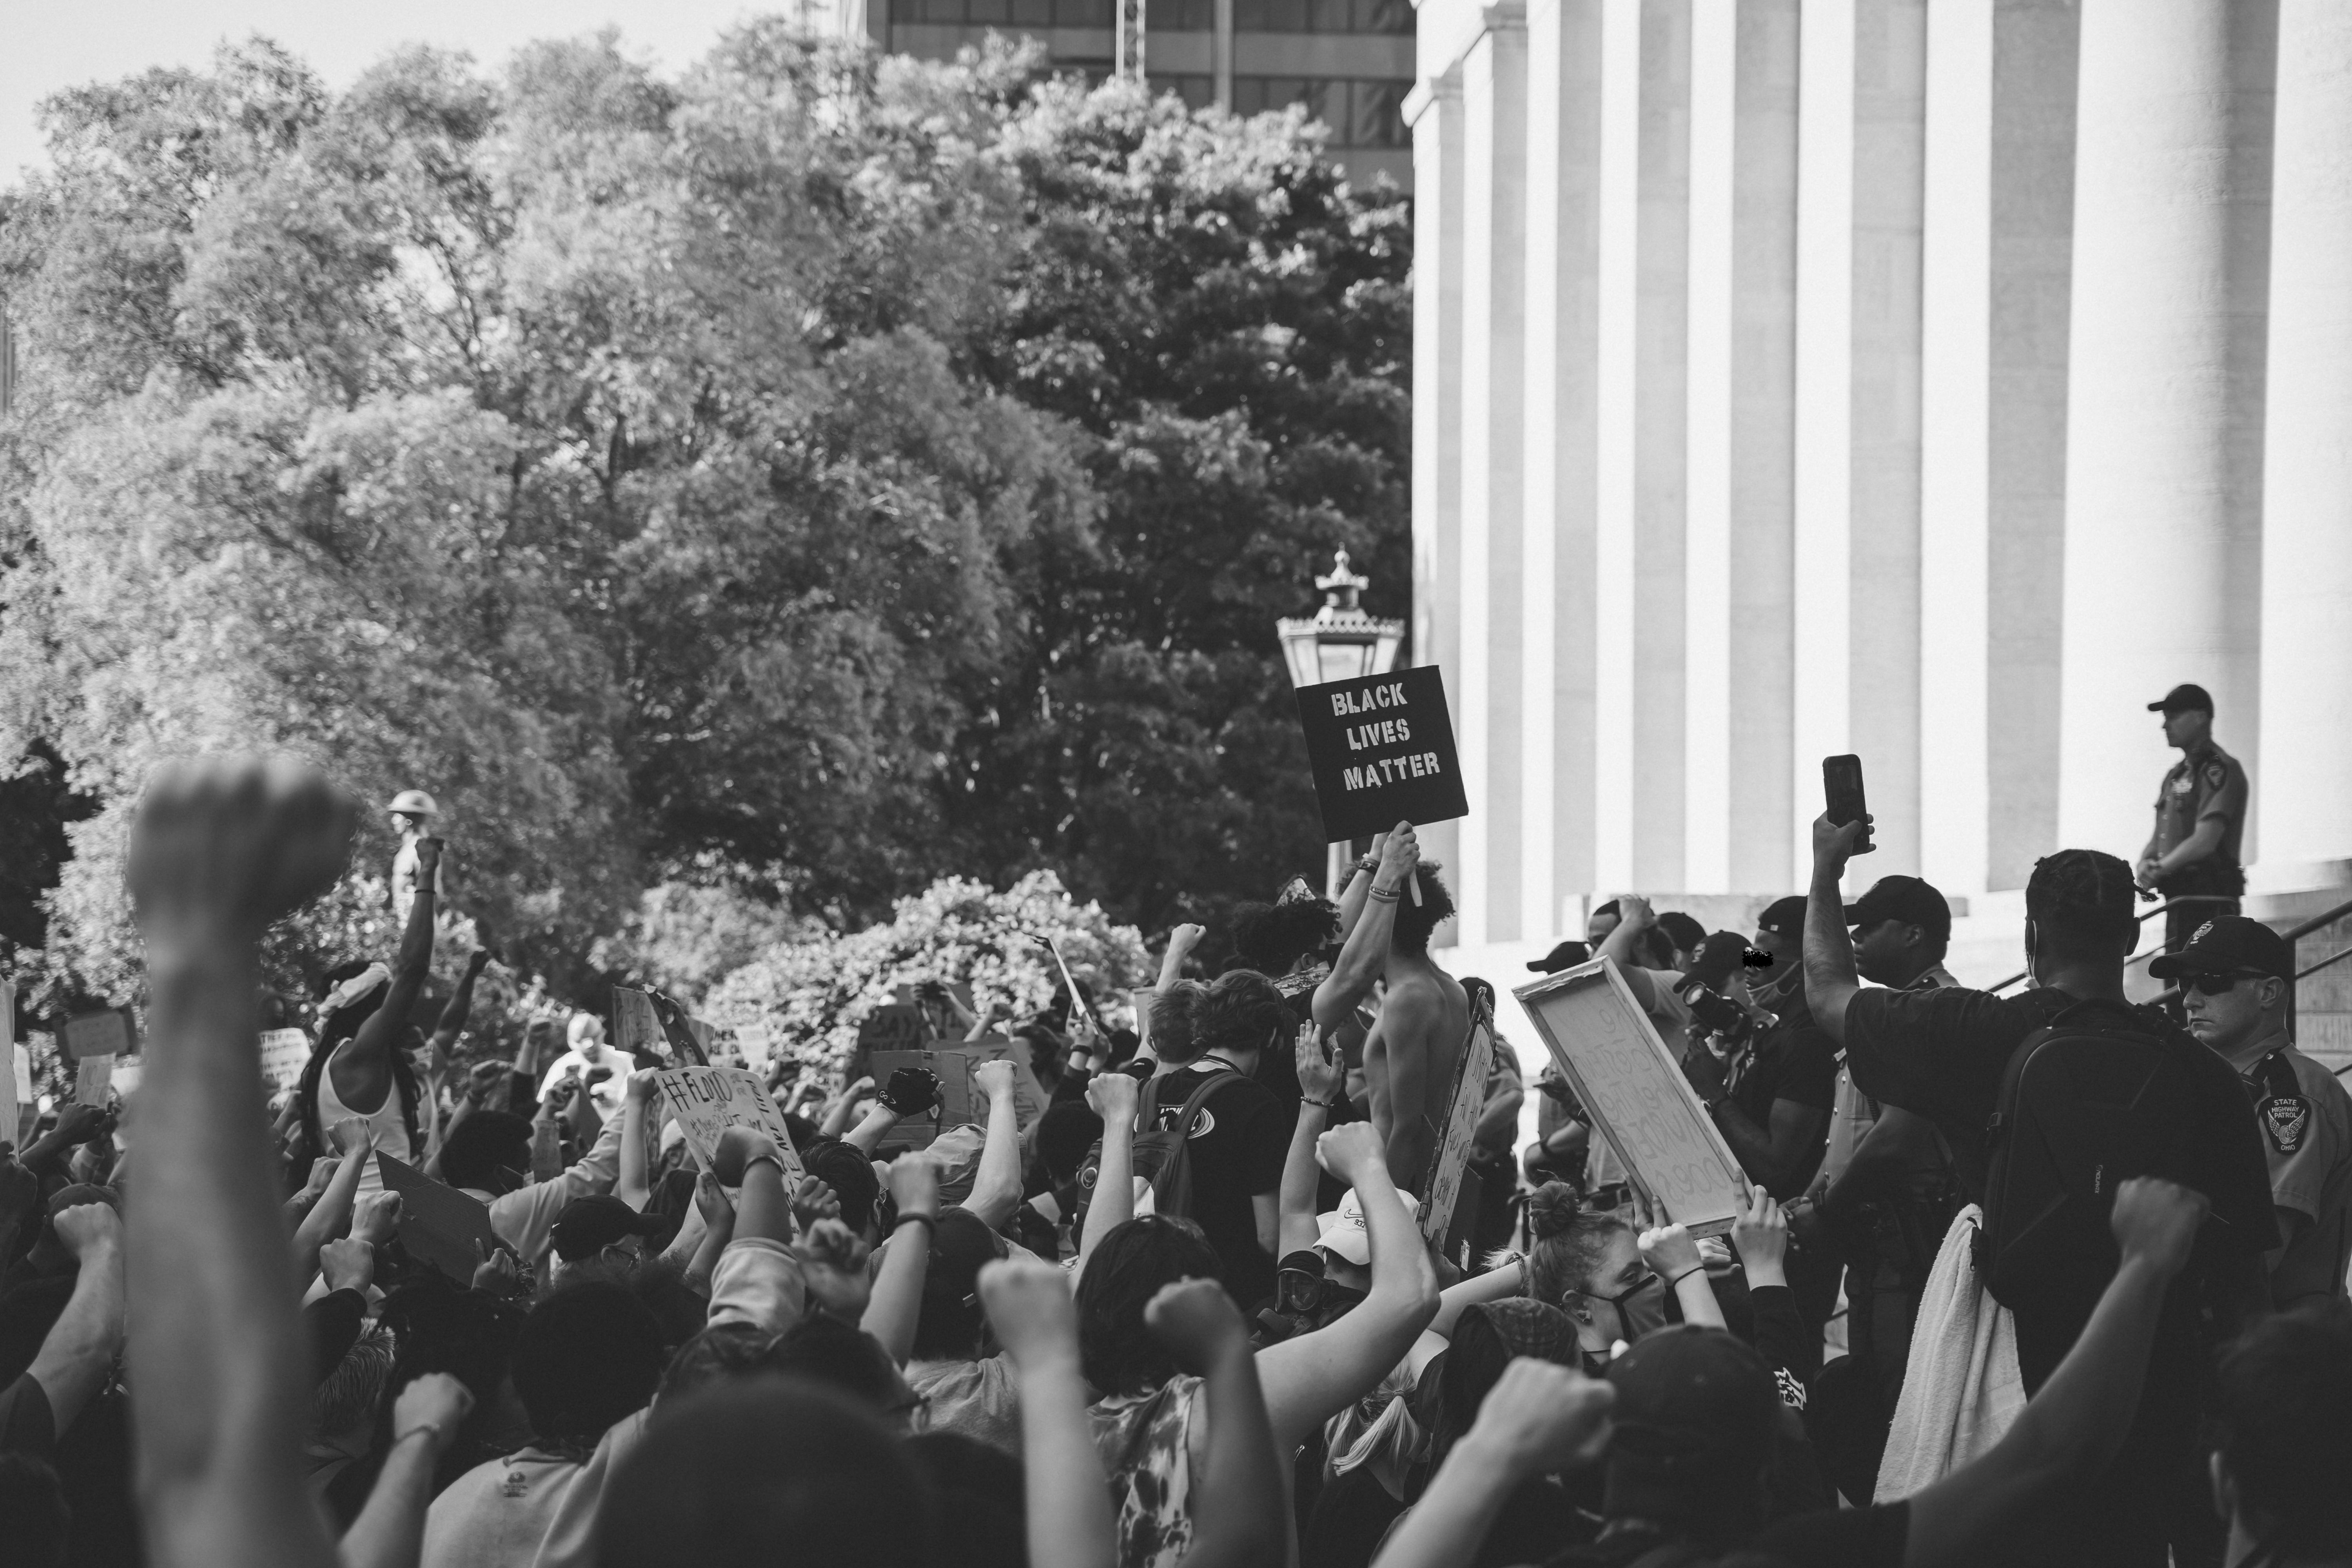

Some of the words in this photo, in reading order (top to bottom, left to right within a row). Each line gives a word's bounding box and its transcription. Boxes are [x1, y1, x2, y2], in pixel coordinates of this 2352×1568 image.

[1331, 682, 1408, 716] BLACK
[1346, 719, 1410, 750] LIVES
[1343, 752, 1441, 791] MATTER
